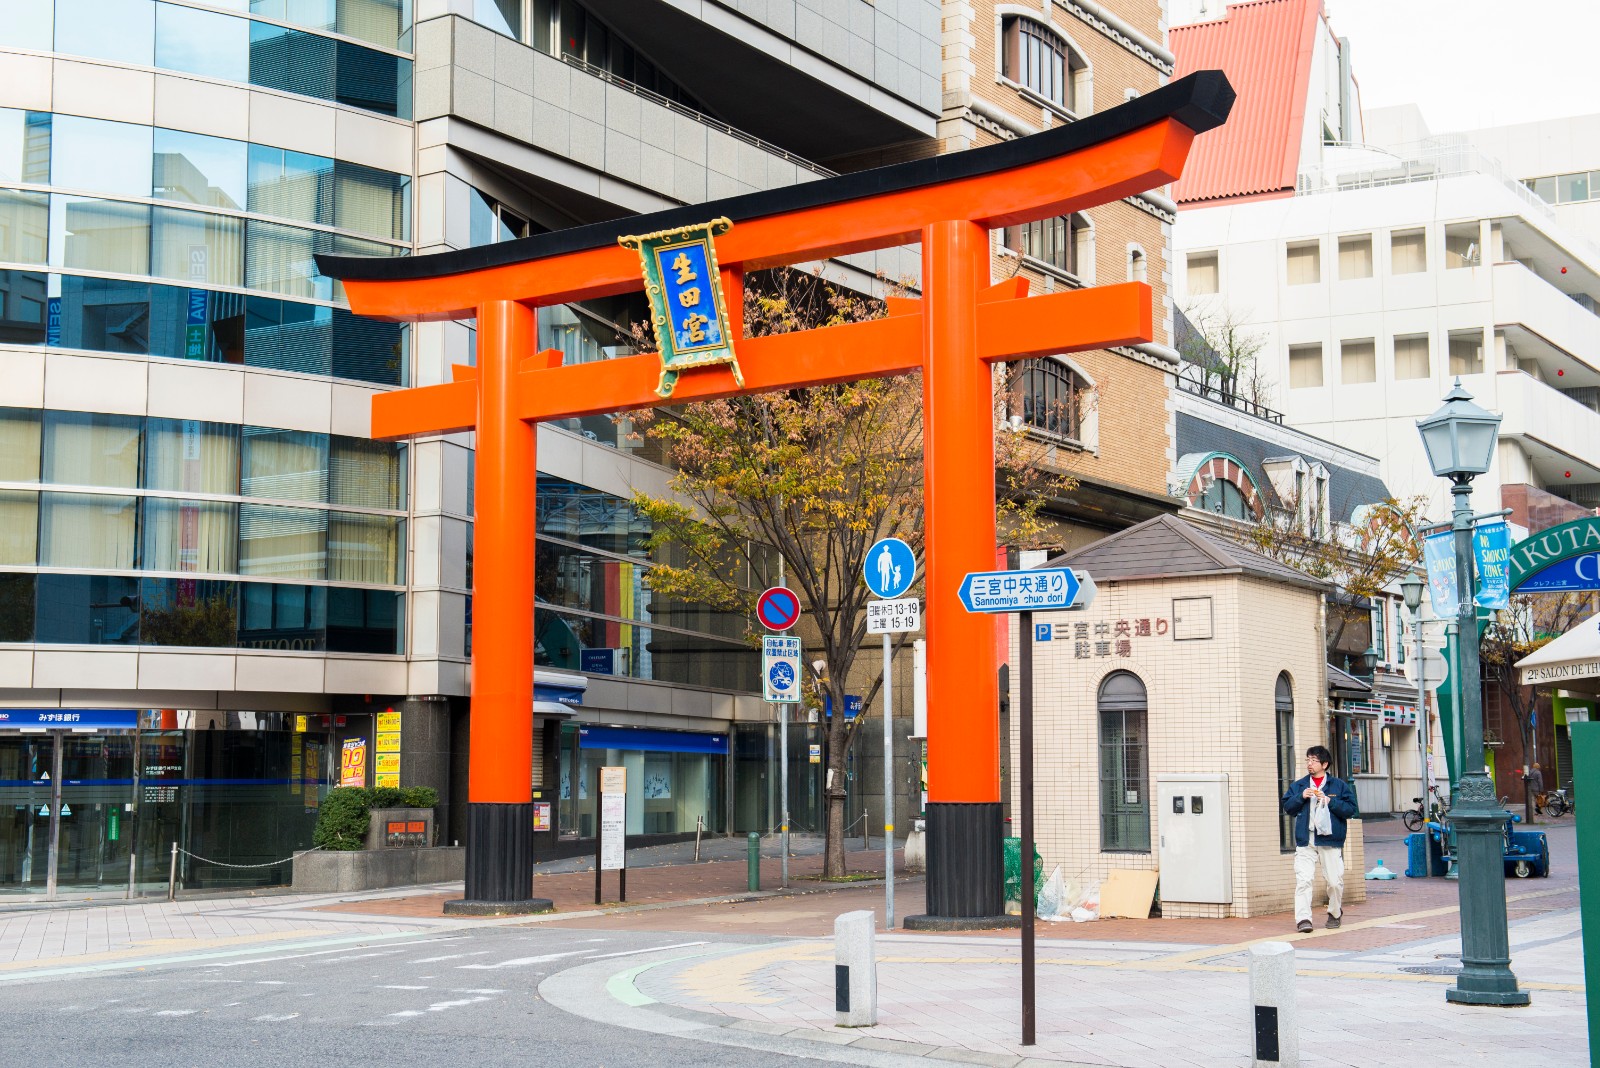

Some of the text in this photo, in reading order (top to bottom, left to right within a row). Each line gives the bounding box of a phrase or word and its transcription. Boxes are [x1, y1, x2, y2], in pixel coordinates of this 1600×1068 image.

[671, 252, 708, 343] 生田宮
[1510, 523, 1600, 574] IKUTA
[1482, 563, 1504, 577] ZONE
[973, 575, 1063, 596] 三宮中央通り
[894, 602, 918, 615] 13-19
[974, 595, 1018, 606] Sannomiya
[1047, 592, 1063, 603] dori
[891, 615, 914, 628] 15-19
[1038, 617, 1168, 640] P 三宮中央通り
[1074, 639, 1132, 659] 駐車場
[1527, 662, 1600, 680] 2F SALON DE TH
[38, 713, 81, 722] みずほ銀行
[343, 747, 365, 767] 10
